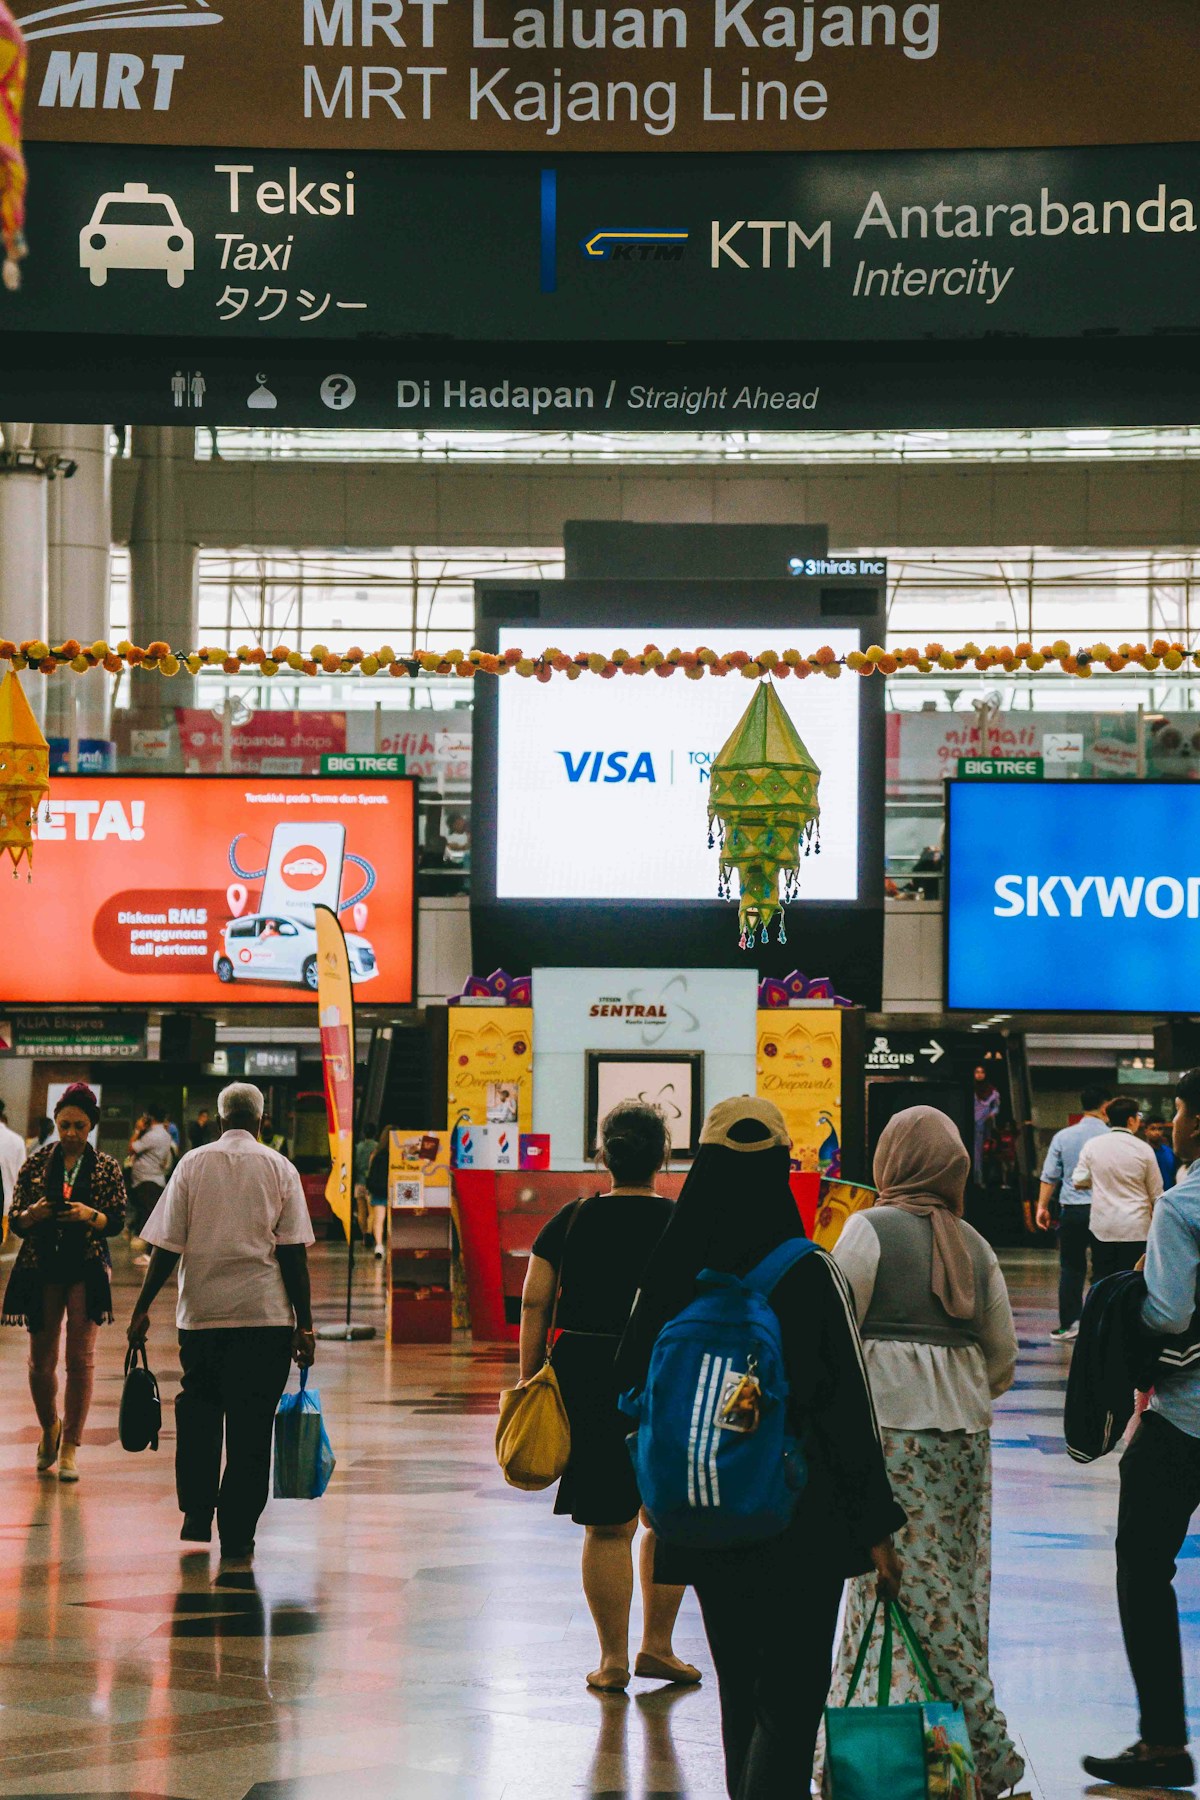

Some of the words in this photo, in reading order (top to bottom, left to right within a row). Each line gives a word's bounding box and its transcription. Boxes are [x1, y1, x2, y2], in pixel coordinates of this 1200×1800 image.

[303, 0, 448, 48] MRT
[472, 0, 687, 49] Laluan
[714, 0, 940, 63] Kajang
[38, 50, 185, 111] MRT
[303, 65, 448, 120] MRT
[469, 67, 677, 136] Kajang
[703, 67, 828, 121] Line
[214, 164, 355, 216] Teksi
[853, 183, 1197, 239] Antarabanda
[214, 234, 294, 271] Taxi
[711, 220, 832, 269] KTM
[852, 259, 1014, 304] Intercity
[215, 285, 368, 322] タクシー
[397, 380, 431, 408] Di
[443, 380, 594, 415] Hadapan
[604, 380, 616, 409] /
[627, 385, 728, 415] Straight
[732, 386, 820, 410] Ahead
[805, 559, 857, 575] 3thirds
[860, 560, 885, 575] Inc
[212, 732, 286, 749] fodpanda
[327, 757, 355, 772] BIG
[357, 757, 398, 772] TREE
[554, 751, 656, 783] VISA
[965, 760, 992, 774] BIG
[994, 760, 1037, 775] TREE
[286, 793, 311, 804] pada
[311, 793, 339, 803] Terma
[339, 794, 357, 804] dan
[31, 800, 145, 841] ETA!
[117, 911, 167, 925] Diskaun
[168, 908, 207, 925] RM5
[130, 929, 207, 942] penggunaan
[130, 943, 153, 955] kali
[154, 944, 207, 957] pertama
[589, 1005, 667, 1018] SENTRAL
[868, 1053, 915, 1064] REGIS
